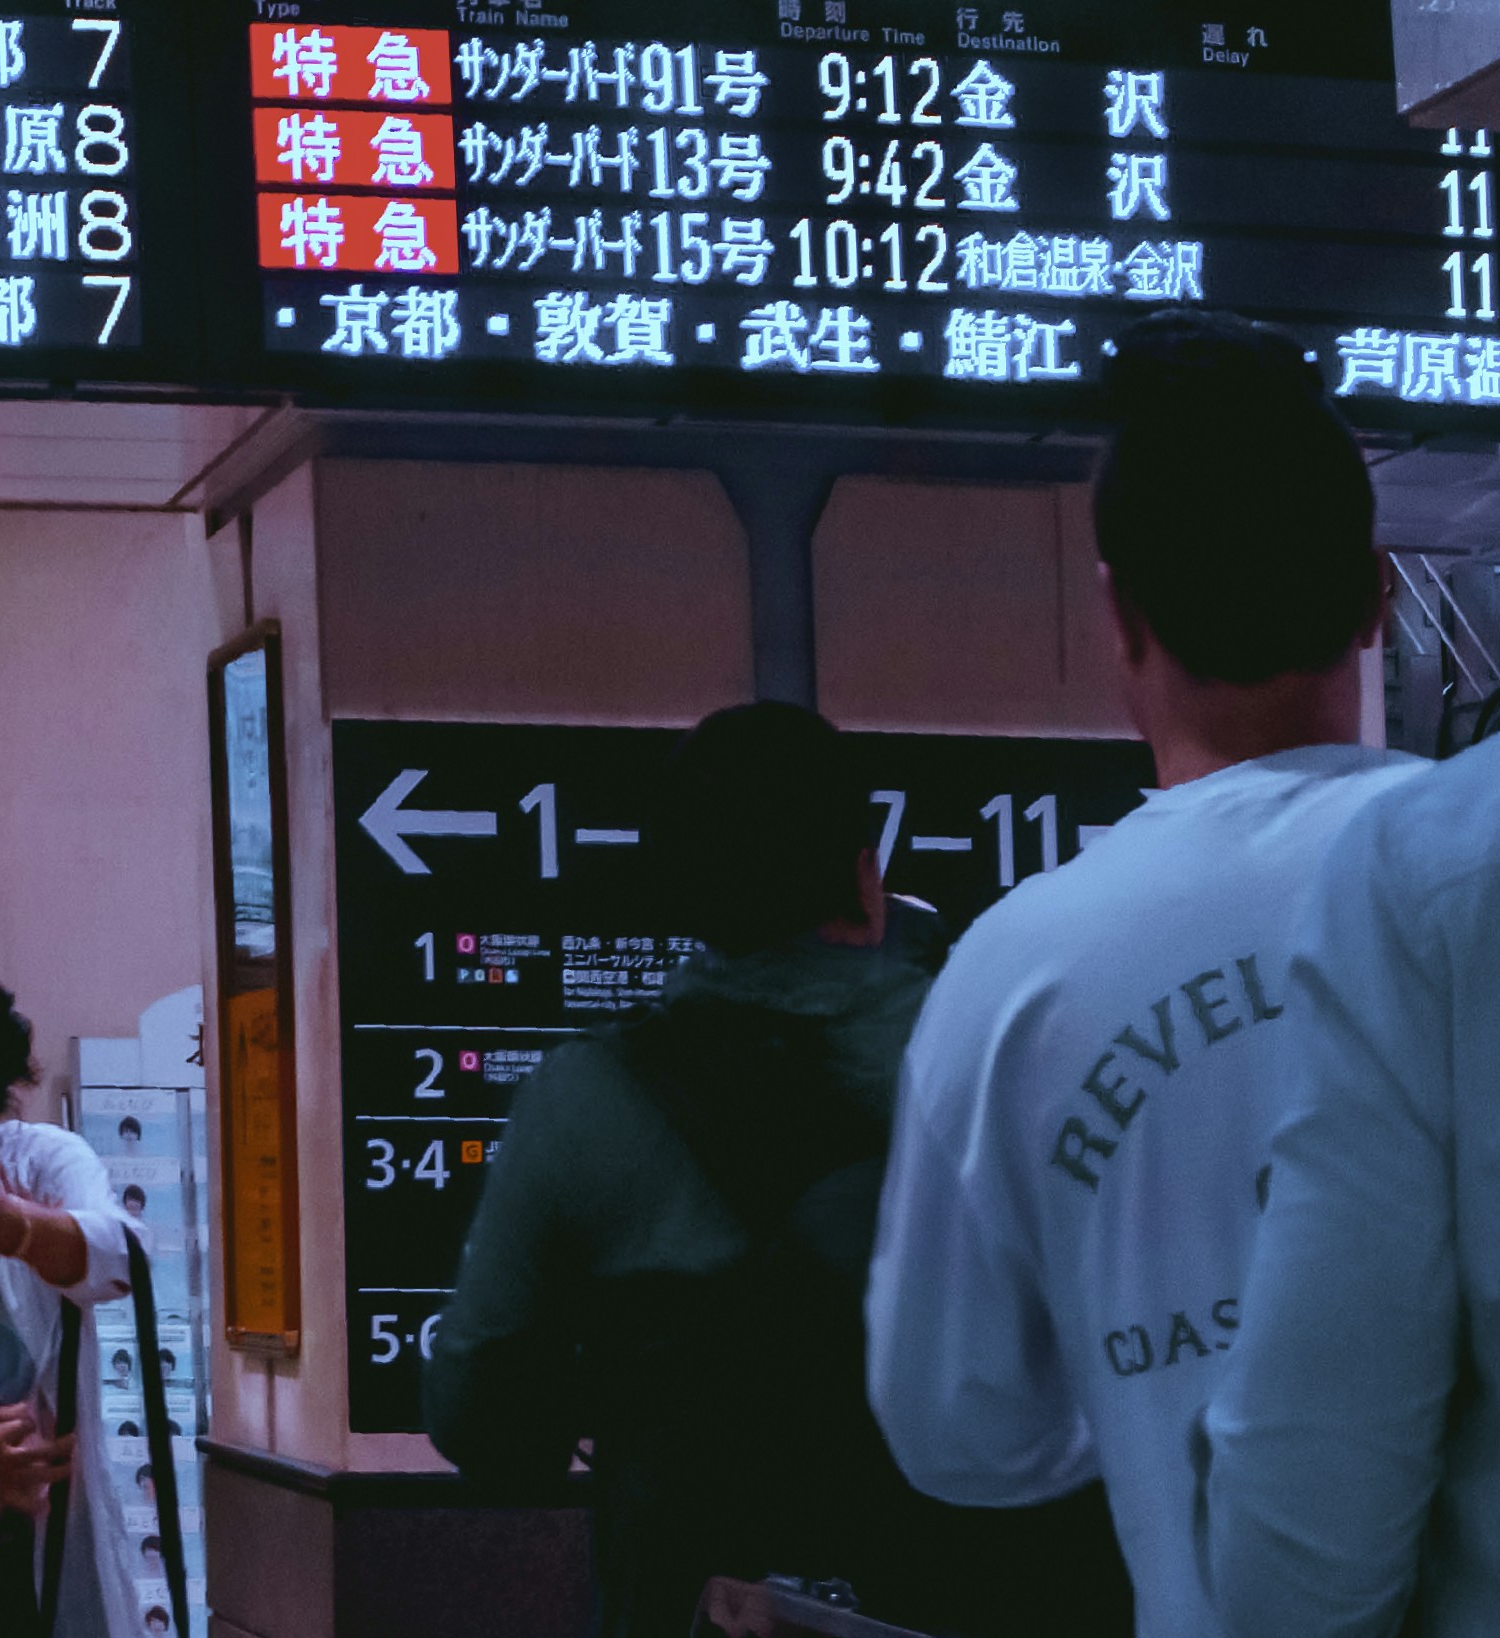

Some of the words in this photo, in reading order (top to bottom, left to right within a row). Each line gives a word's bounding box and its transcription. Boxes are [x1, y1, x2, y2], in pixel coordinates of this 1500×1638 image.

[72, 18, 122, 89] 7
[457, 8, 505, 25] Train
[515, 11, 569, 28] Name
[779, 22, 870, 43] Departure
[880, 28, 926, 47] Time
[957, 32, 1061, 53] Destination
[1202, 47, 1250, 68] Delay
[273, 29, 431, 101] 特急
[818, 53, 943, 126] 9:12
[74, 104, 130, 178] 8
[276, 114, 434, 187] 特急
[822, 135, 947, 212] 9:42
[1438, 169, 1494, 238] 11
[78, 189, 133, 263] 8
[279, 199, 437, 272] 特急
[789, 217, 950, 294] 10:12
[1441, 250, 1496, 318] 11
[81, 275, 131, 346] 7
[415, 932, 436, 982] 1
[414, 1047, 446, 1099] 2
[1049, 953, 1285, 1195] REVEL
